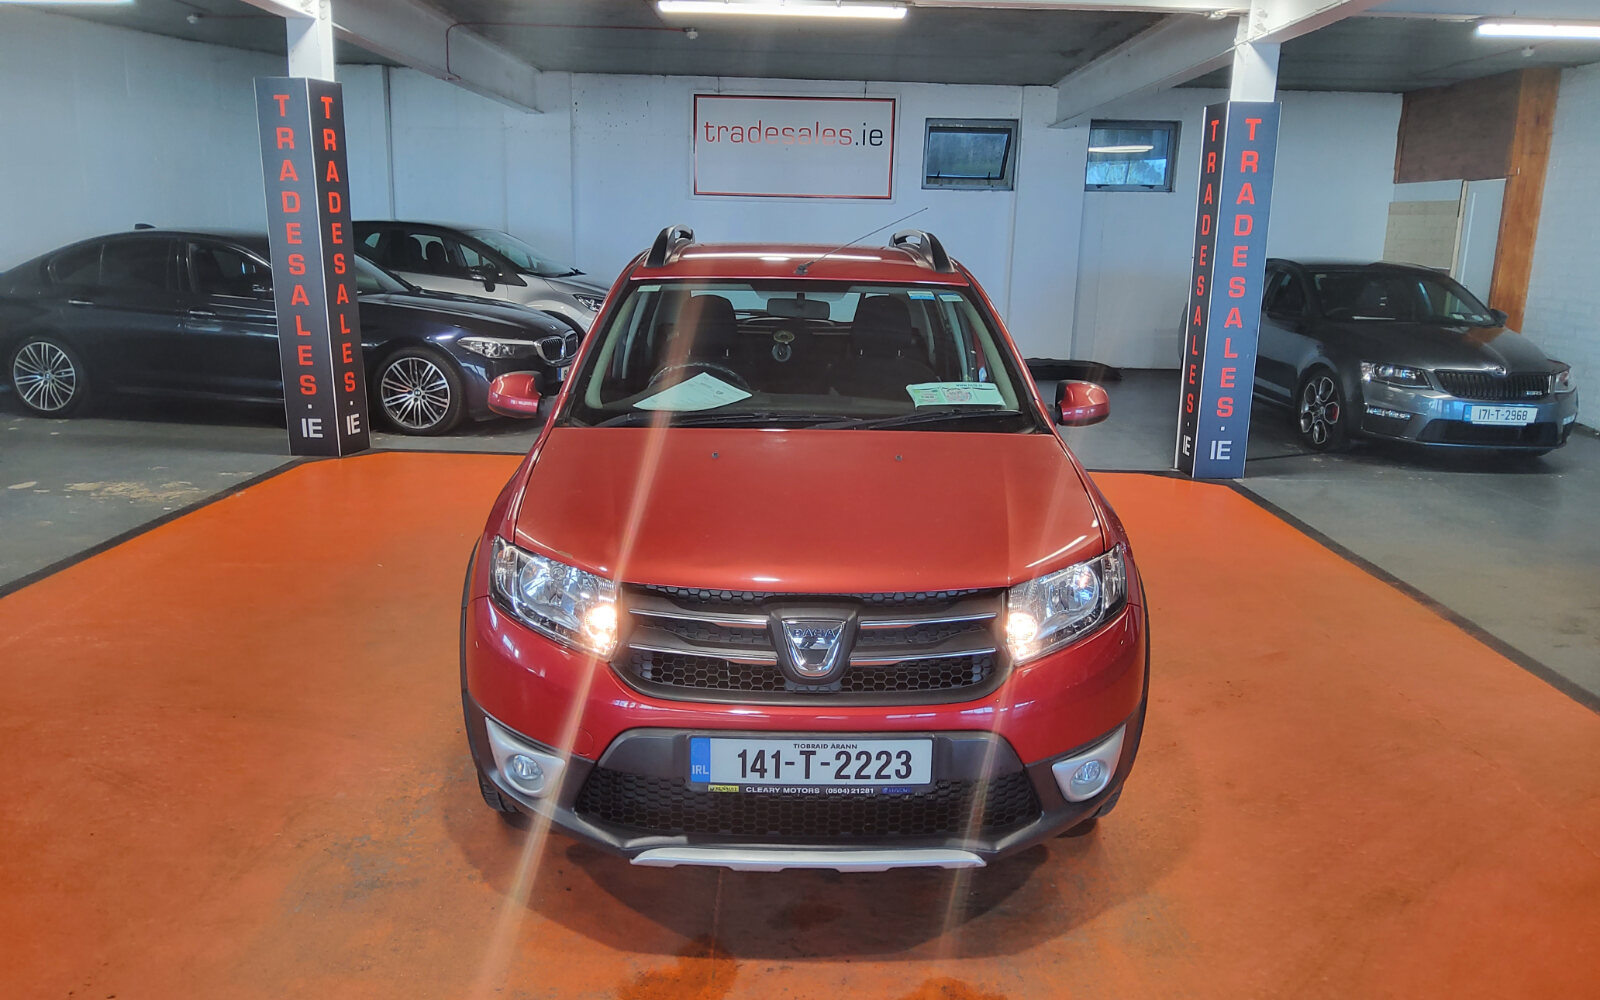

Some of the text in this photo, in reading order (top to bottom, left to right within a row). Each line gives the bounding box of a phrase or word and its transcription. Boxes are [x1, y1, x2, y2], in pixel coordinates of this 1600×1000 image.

[704, 119, 884, 146] tradesales.ie
[1478, 408, 1529, 421] 171-T-2968
[692, 764, 709, 775] IRL
[737, 748, 912, 780] 141-T-2223
